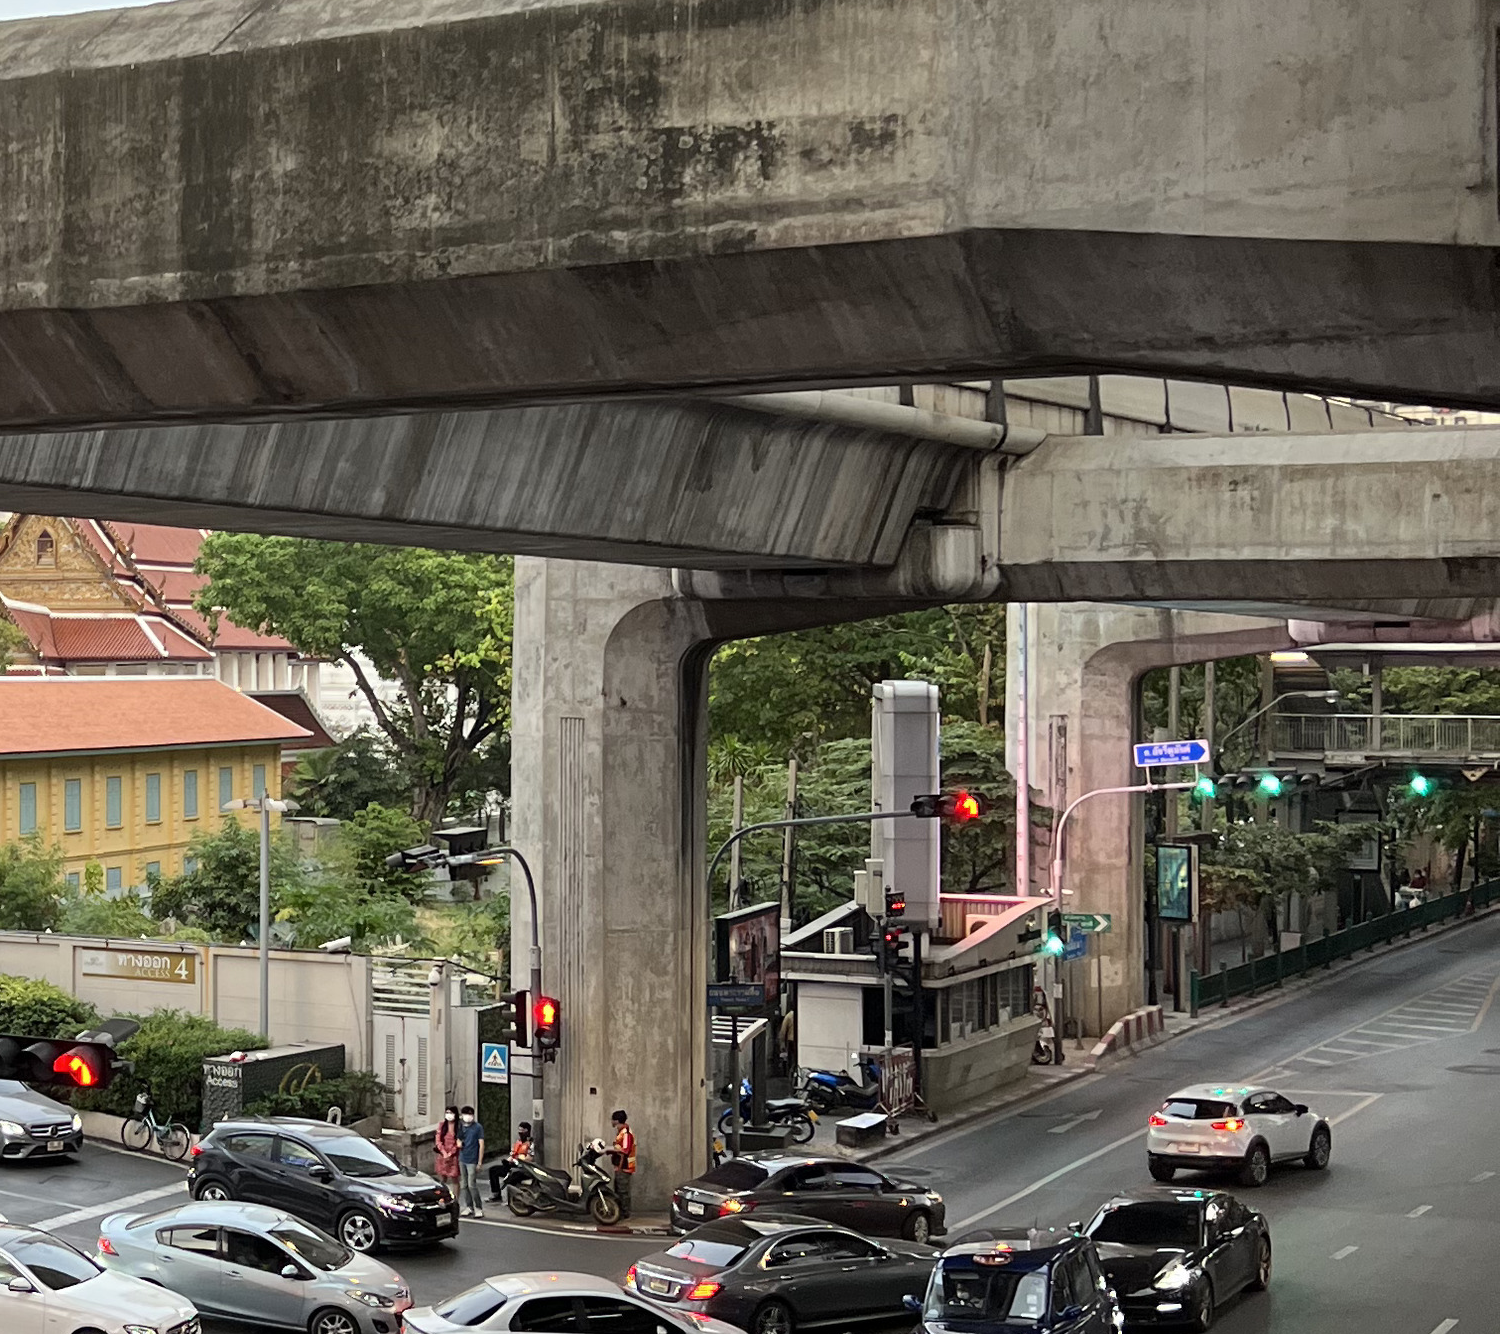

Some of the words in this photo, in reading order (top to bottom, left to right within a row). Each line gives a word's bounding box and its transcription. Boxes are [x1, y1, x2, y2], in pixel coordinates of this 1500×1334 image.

[117, 954, 171, 969] ทางออก
[174, 957, 189, 980] 4
[135, 968, 171, 979] ACCESS
[206, 1075, 238, 1088] Access
